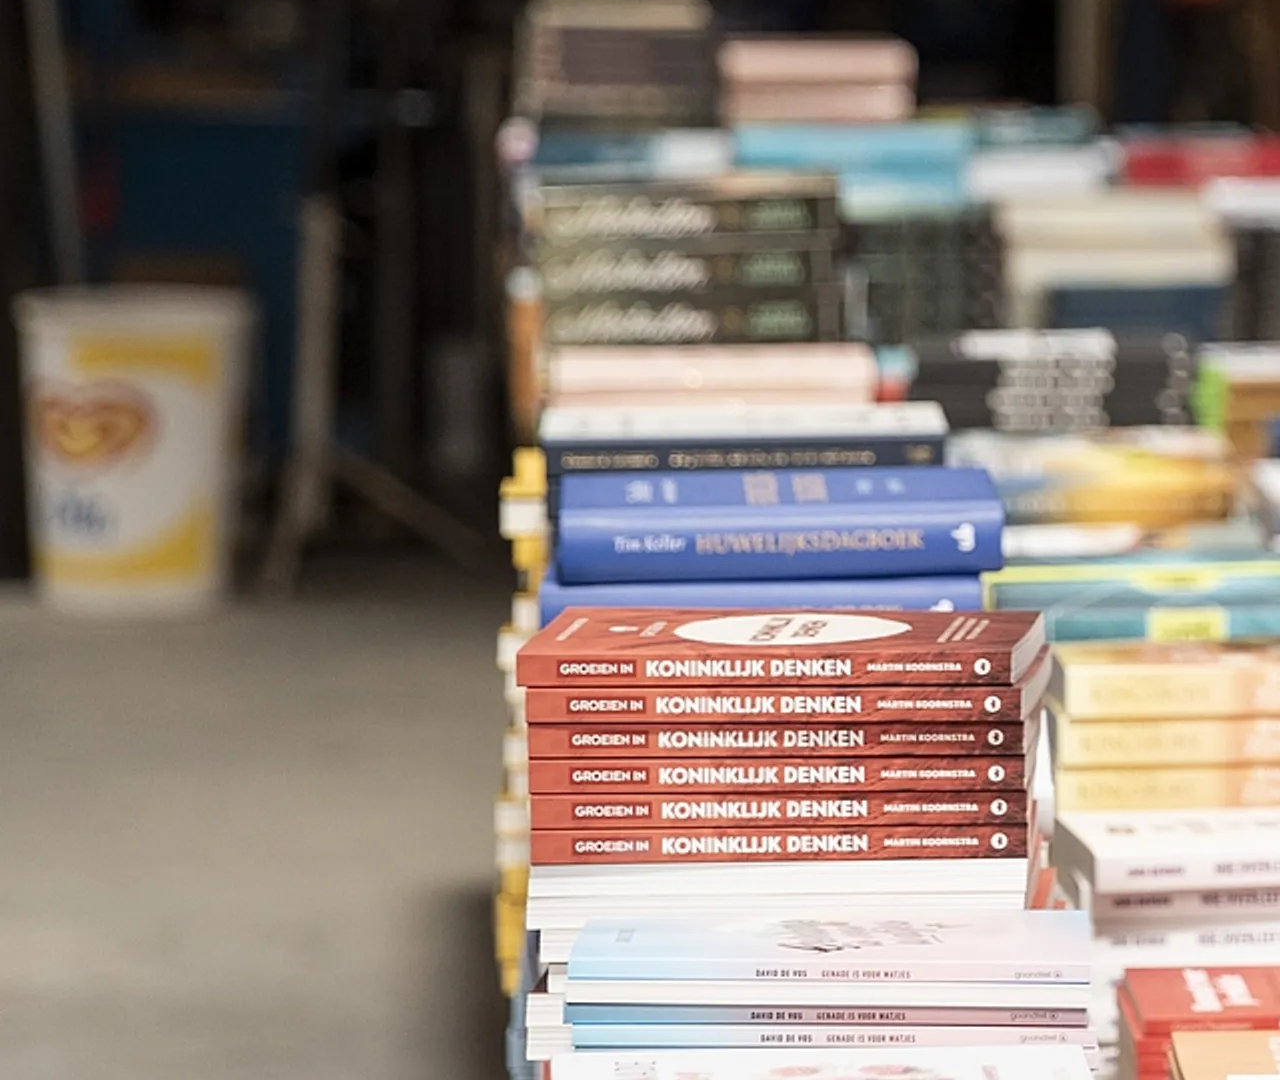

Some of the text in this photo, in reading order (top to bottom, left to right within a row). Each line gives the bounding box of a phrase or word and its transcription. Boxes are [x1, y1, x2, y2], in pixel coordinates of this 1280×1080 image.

[560, 663, 617, 675] GROEIEN
[621, 663, 633, 674] IN
[646, 660, 766, 677] KONINKLIJK
[770, 659, 851, 676] DENKEN
[867, 663, 902, 671] MARTIN
[570, 700, 627, 711] GROEIEN
[630, 700, 643, 710] IN
[656, 696, 775, 713] KONINKLIJK
[781, 696, 861, 712] DENKEN
[877, 700, 912, 708] MARTIN
[572, 735, 629, 746] GROEIEN
[632, 735, 645, 745] IN
[658, 731, 777, 748] KONINKLIJK
[783, 731, 863, 747] DENKEN
[573, 771, 630, 782] GROEIEN
[633, 771, 646, 781] IN
[659, 767, 778, 784] KONINKLIJK
[784, 766, 864, 782] DENKEN
[881, 770, 916, 778] MARTIN
[575, 806, 632, 817] GROEIEN
[636, 806, 649, 816] IN
[661, 801, 781, 819] KONINKLIJK
[787, 800, 867, 817] DENKEN
[884, 804, 919, 812] MARTIN
[576, 841, 633, 852] GROEIEN
[636, 841, 649, 851] IN
[662, 836, 781, 854] KONINKLIJK
[787, 835, 868, 852] DENKEN
[884, 838, 919, 846] MARTIN
[756, 969, 778, 977] DAVID
[781, 969, 790, 977] DE
[821, 970, 850, 978] GENADE
[751, 1011, 773, 1019] DAVID
[776, 1011, 785, 1019] DE
[816, 1011, 845, 1020] GENADE
[761, 1034, 783, 1042] DAVID
[786, 1034, 795, 1042] DE
[827, 1034, 855, 1043] GENADE
